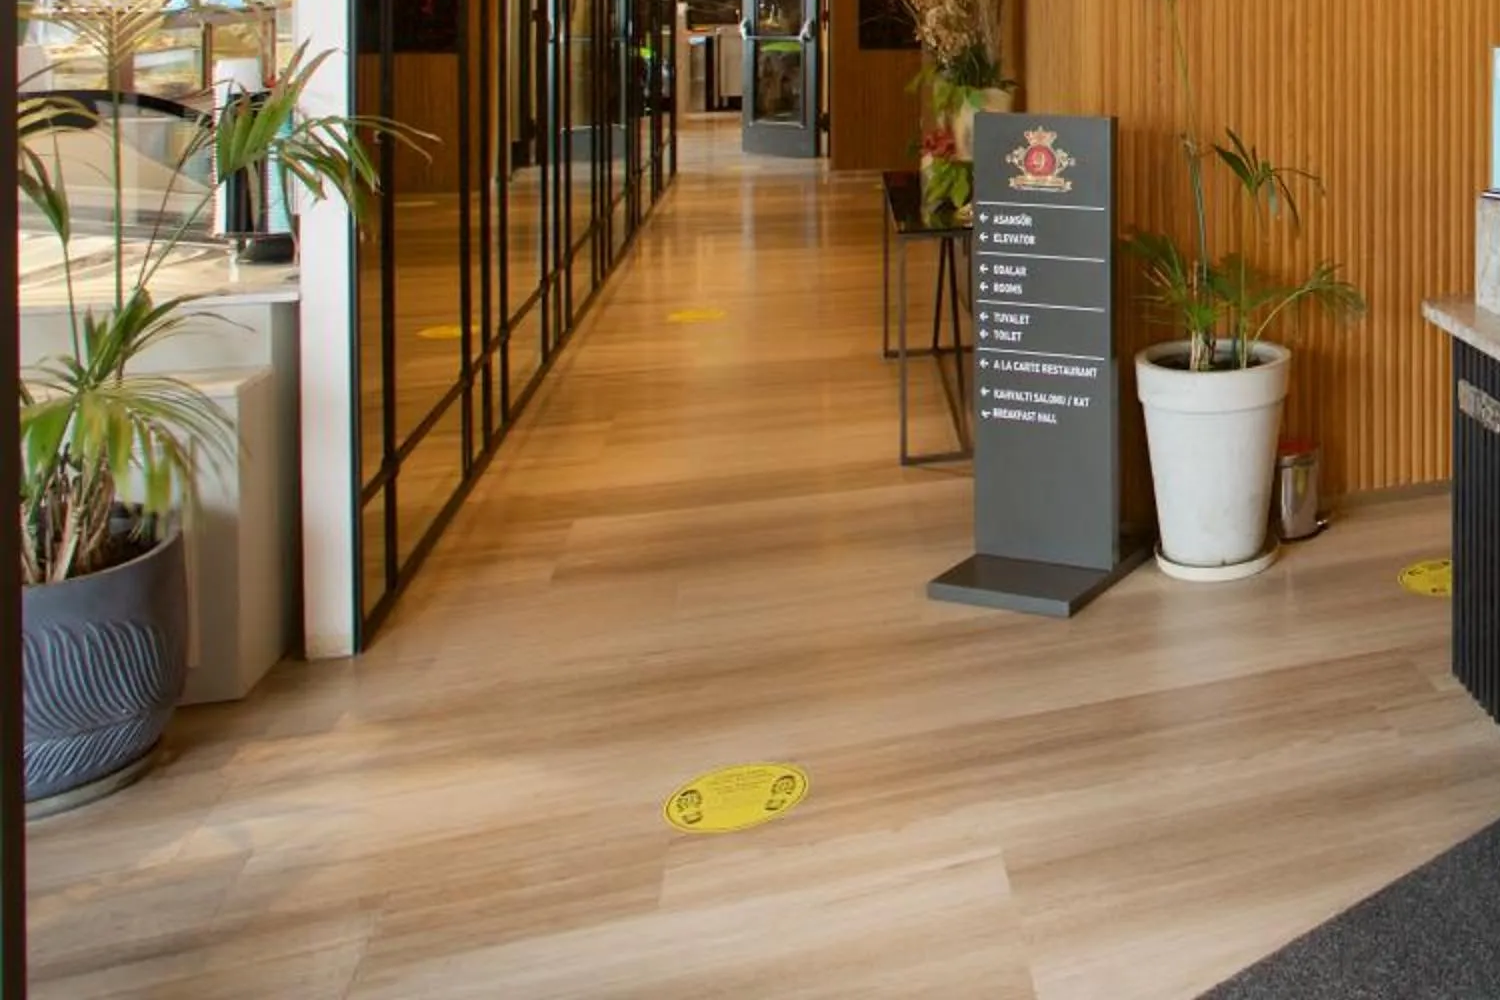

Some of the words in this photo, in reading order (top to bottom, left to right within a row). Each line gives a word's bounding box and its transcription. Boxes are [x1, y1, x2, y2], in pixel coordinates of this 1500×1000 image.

[993, 233, 1036, 245] ELEVATOR
[993, 283, 1022, 294] ROOMS
[994, 330, 1022, 342] TOILET
[993, 360, 1000, 368] A
[1002, 360, 1013, 371] LA
[1014, 361, 1040, 372] CARTE
[1042, 364, 1098, 379] RESTAURANT
[993, 408, 1036, 421] BREAKFAST
